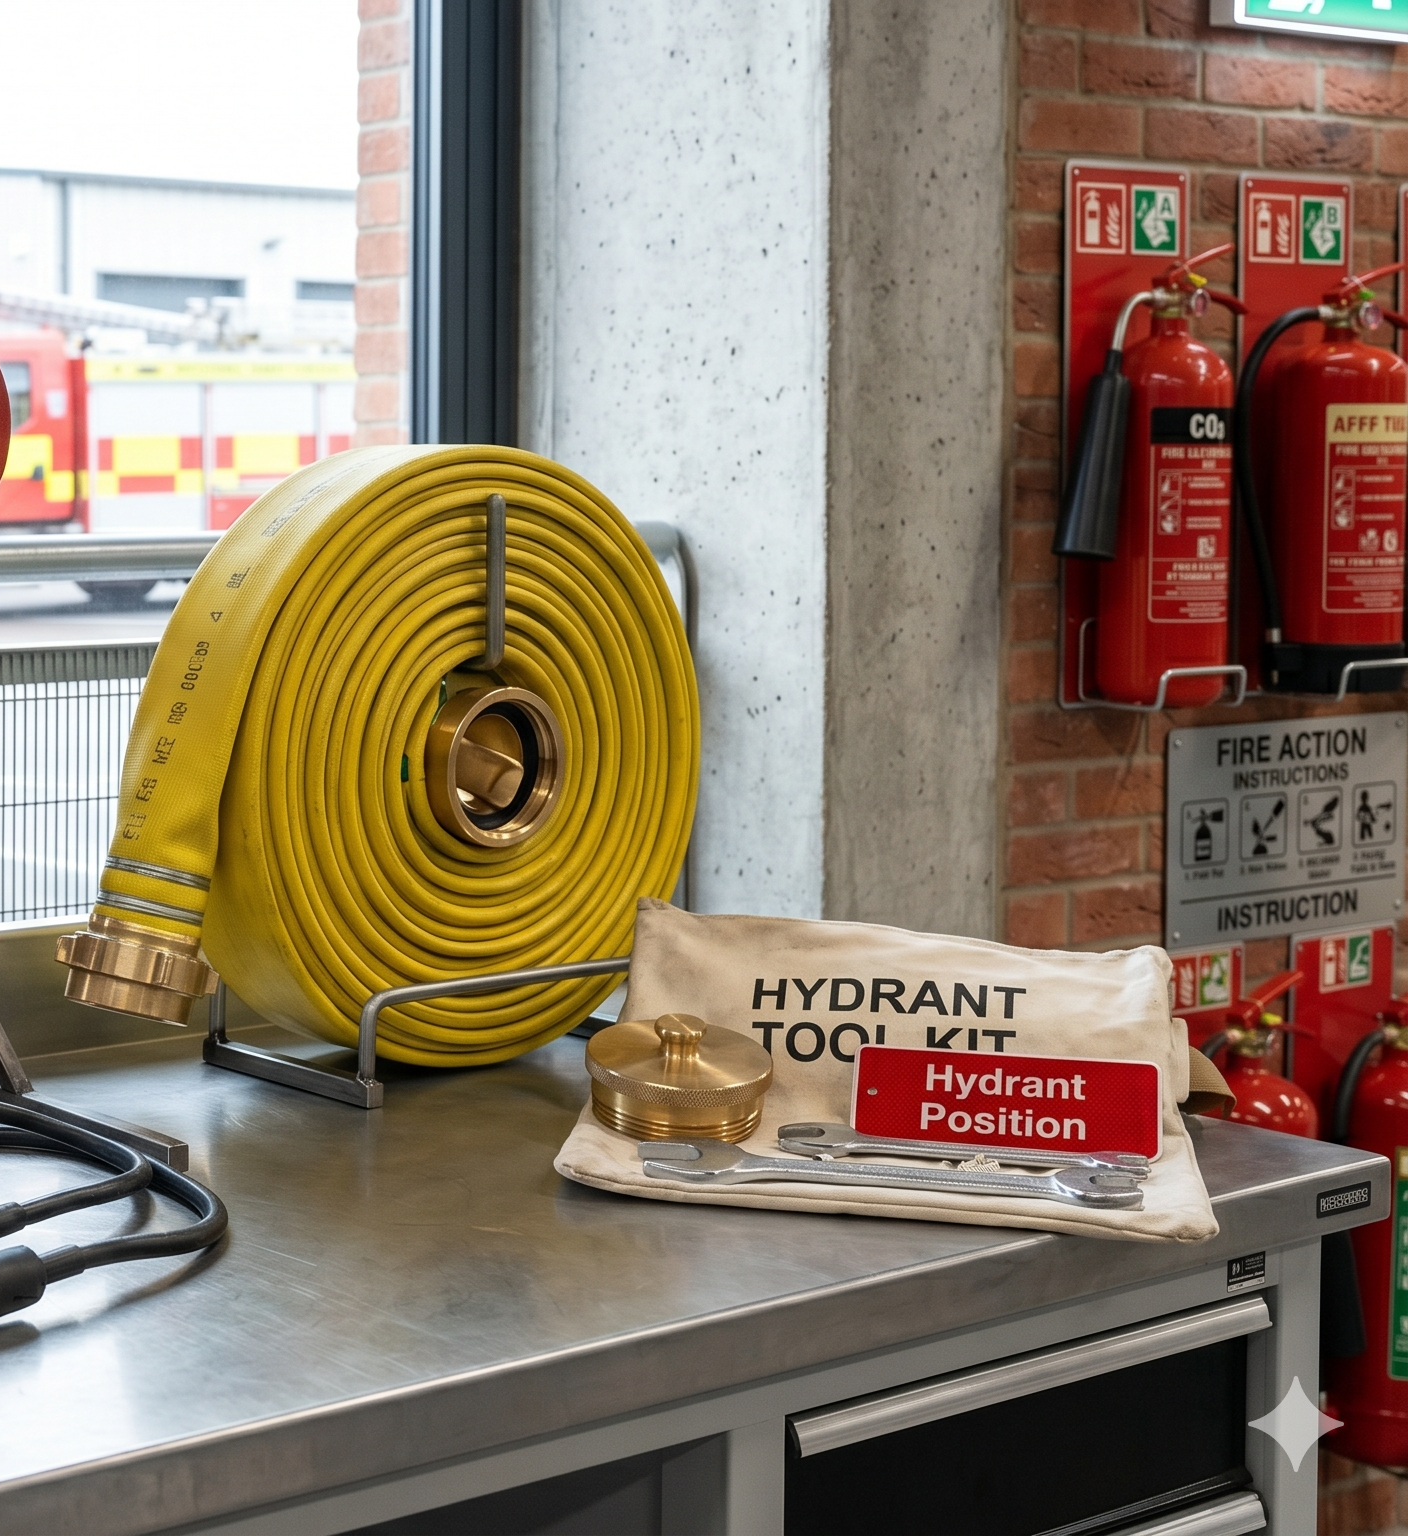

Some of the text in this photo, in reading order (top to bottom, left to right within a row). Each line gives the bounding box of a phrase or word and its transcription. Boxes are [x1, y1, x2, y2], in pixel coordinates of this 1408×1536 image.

[1159, 197, 1172, 217] A
[1326, 206, 1338, 225] B
[1334, 415, 1378, 433] AFFF
[1217, 727, 1367, 767] FIRE ACTION
[1233, 762, 1349, 791] INSTRUCTIONS
[1217, 889, 1359, 932] INSTRUCTION
[752, 978, 1027, 1019] HYDRANT
[926, 1026, 1016, 1053] KIT
[926, 1063, 1087, 1100] Hydrant
[920, 1102, 1086, 1140] Position
